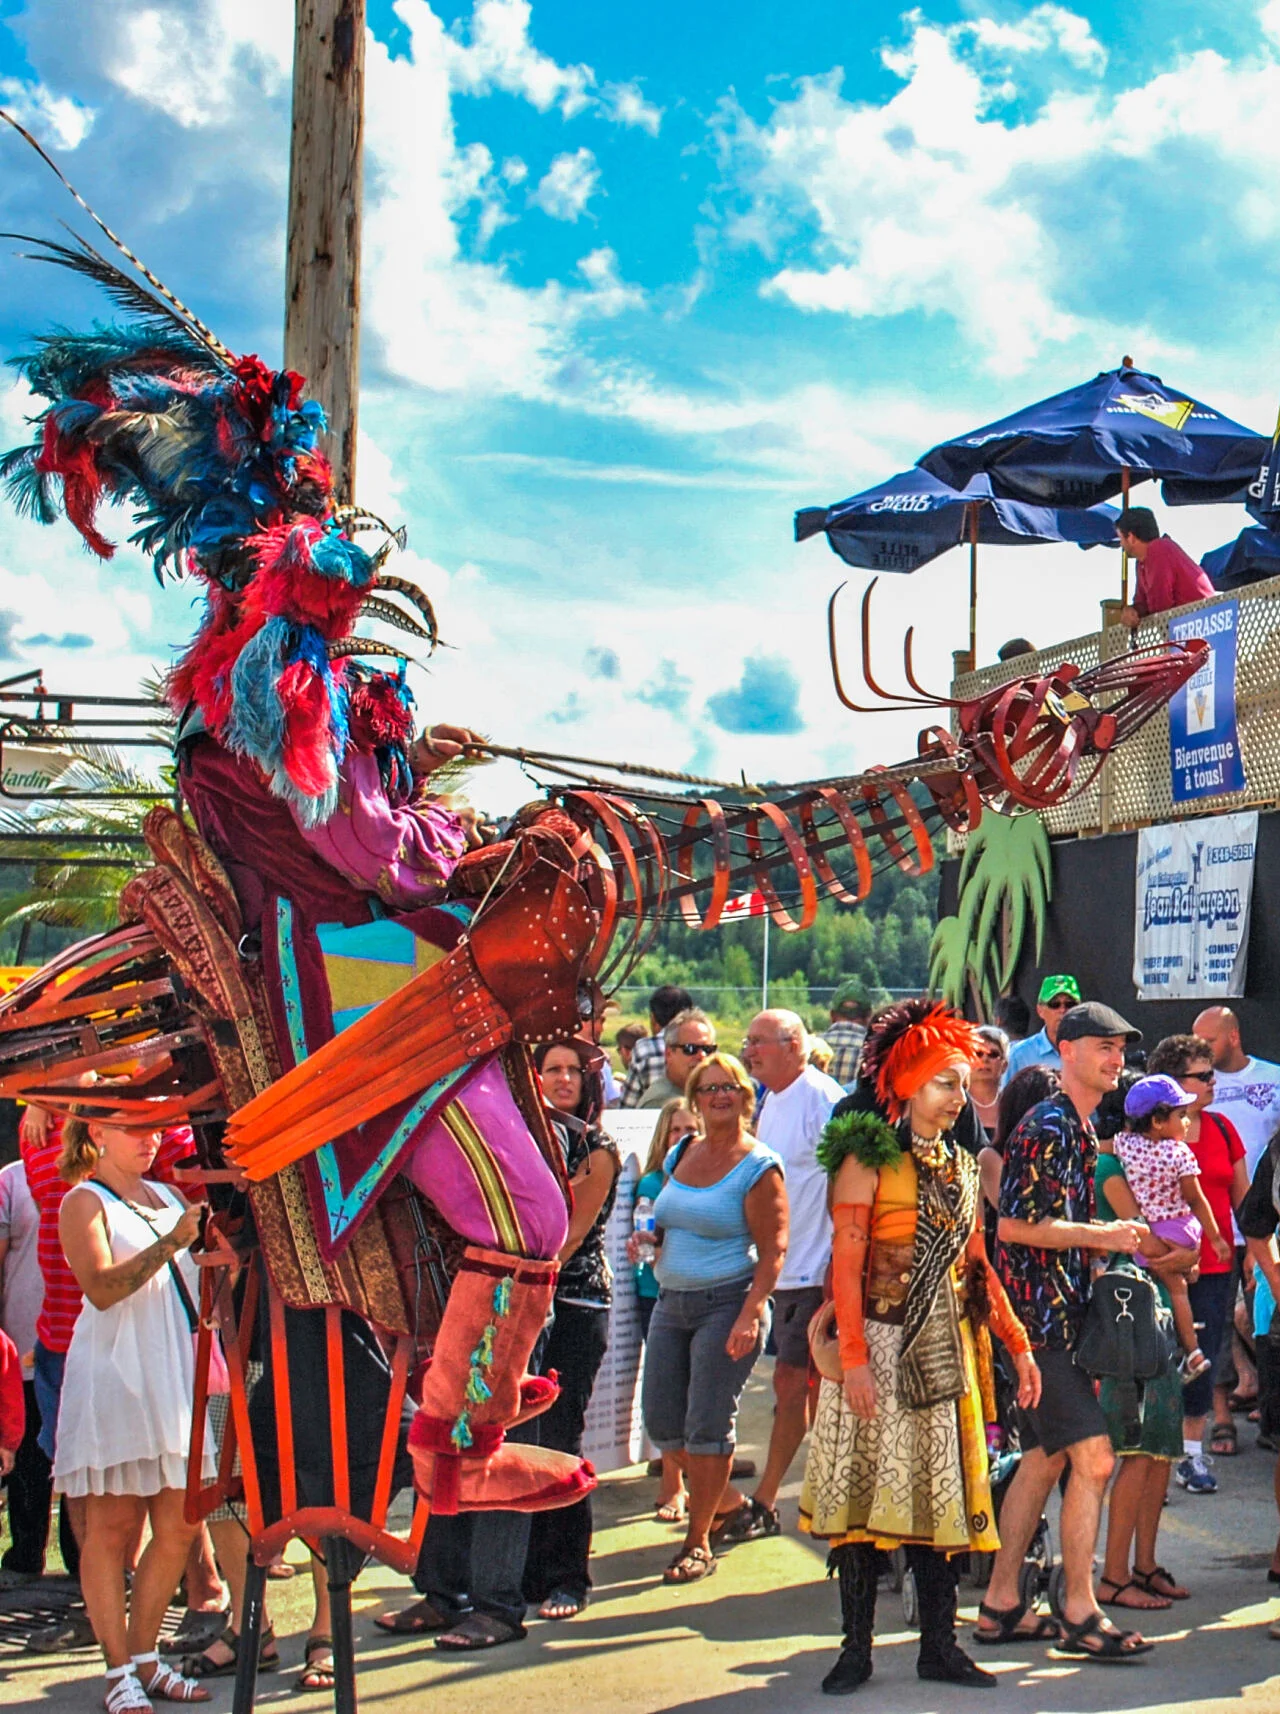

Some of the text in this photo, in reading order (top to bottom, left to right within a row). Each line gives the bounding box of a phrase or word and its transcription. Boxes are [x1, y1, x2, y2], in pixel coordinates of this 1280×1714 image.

[1173, 609, 1233, 643] TERRASSE
[1174, 742, 1235, 770] Bienvenue
[1185, 762, 1224, 791] à tous!
[1208, 943, 1239, 954] COMME
